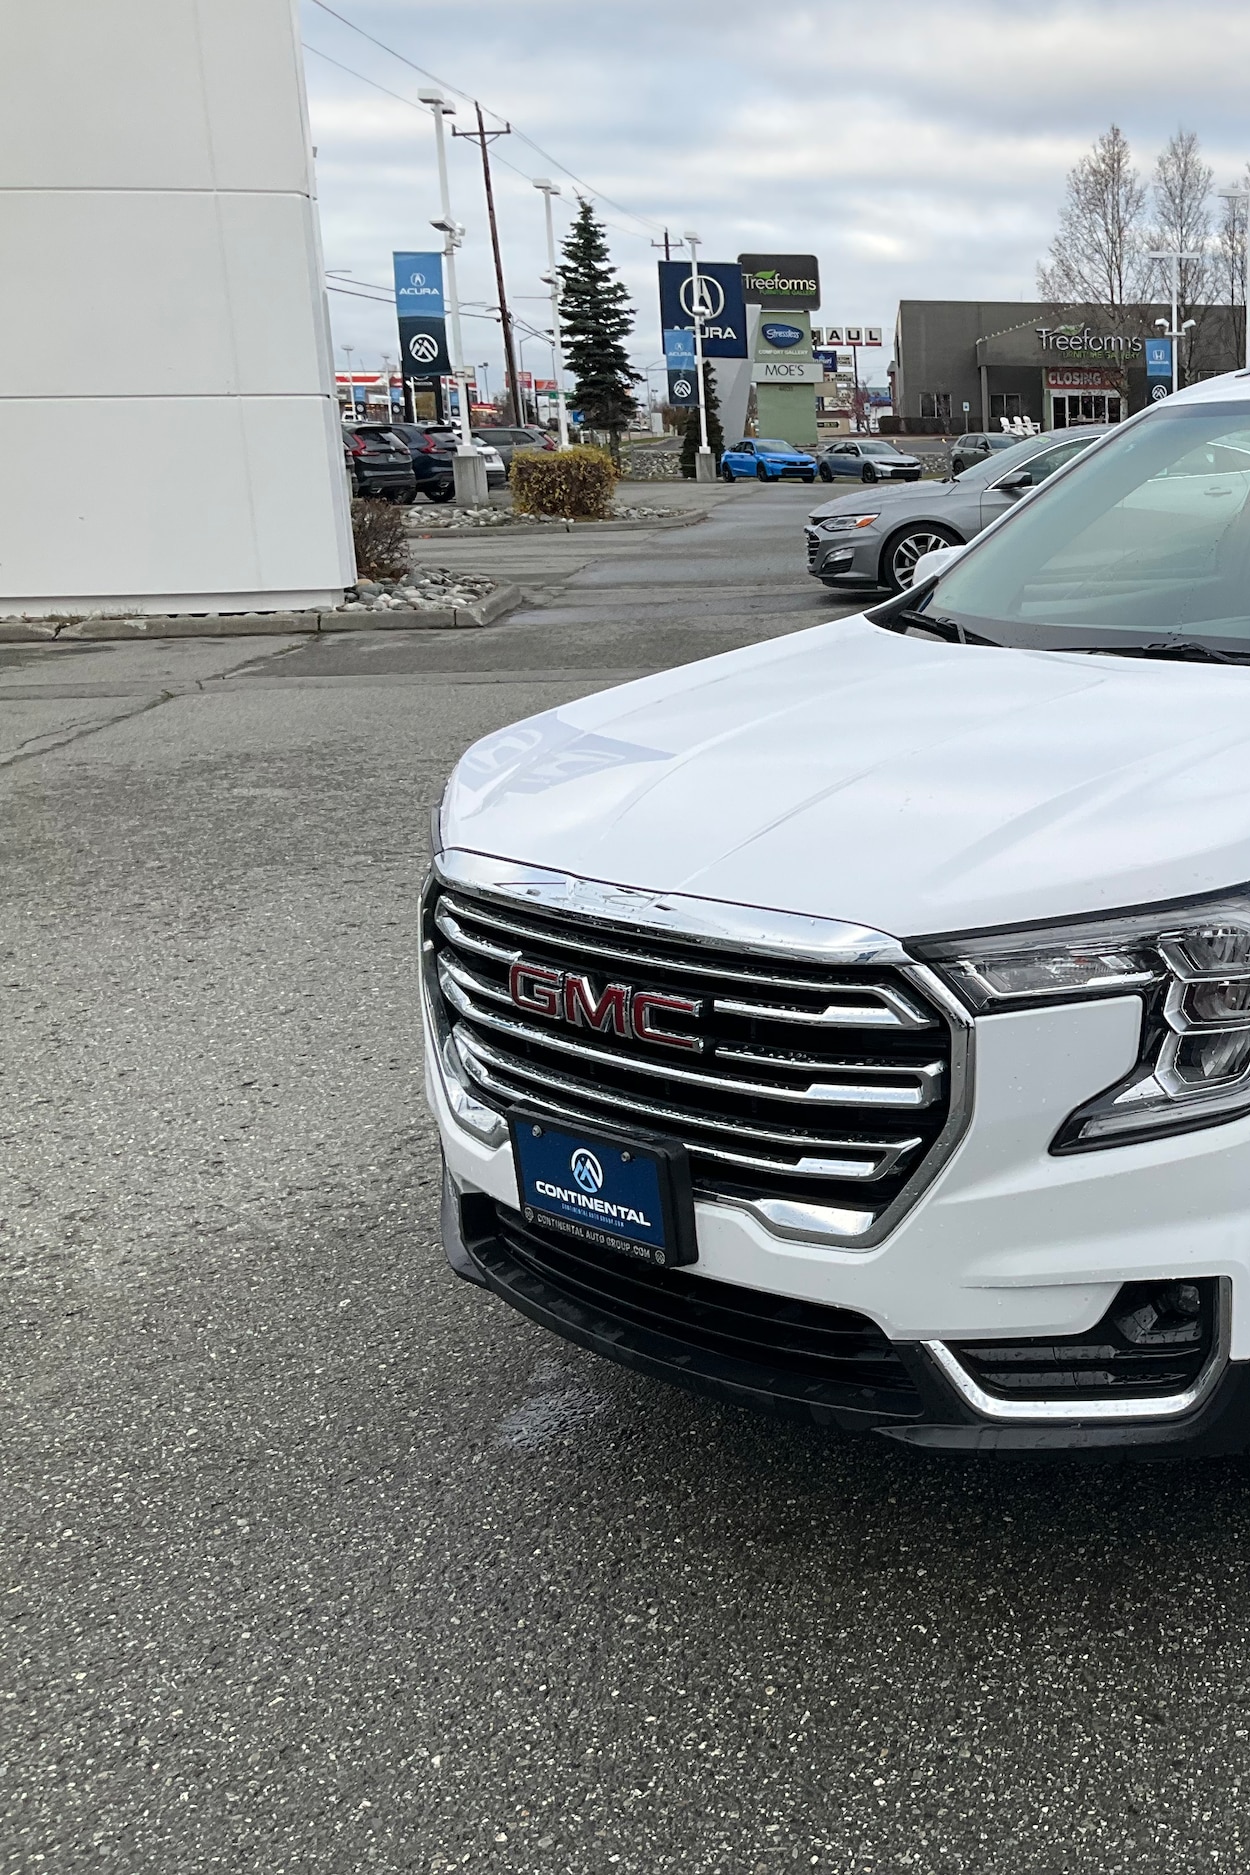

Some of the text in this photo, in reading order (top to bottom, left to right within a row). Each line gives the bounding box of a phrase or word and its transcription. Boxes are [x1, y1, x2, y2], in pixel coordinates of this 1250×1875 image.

[742, 273, 817, 291] Treeforms
[399, 287, 440, 295] ACURA
[673, 325, 737, 340] URA
[766, 329, 800, 340] Stressless
[1035, 327, 1142, 352] Treeforms
[765, 365, 804, 377] MOE'S
[1048, 372, 1102, 386] CLOSING
[509, 960, 704, 1054] GMC
[535, 1180, 651, 1227] CONTINENTAL
[537, 1213, 584, 1237] CONTINENTAL
[586, 1229, 605, 1244] AUTO
